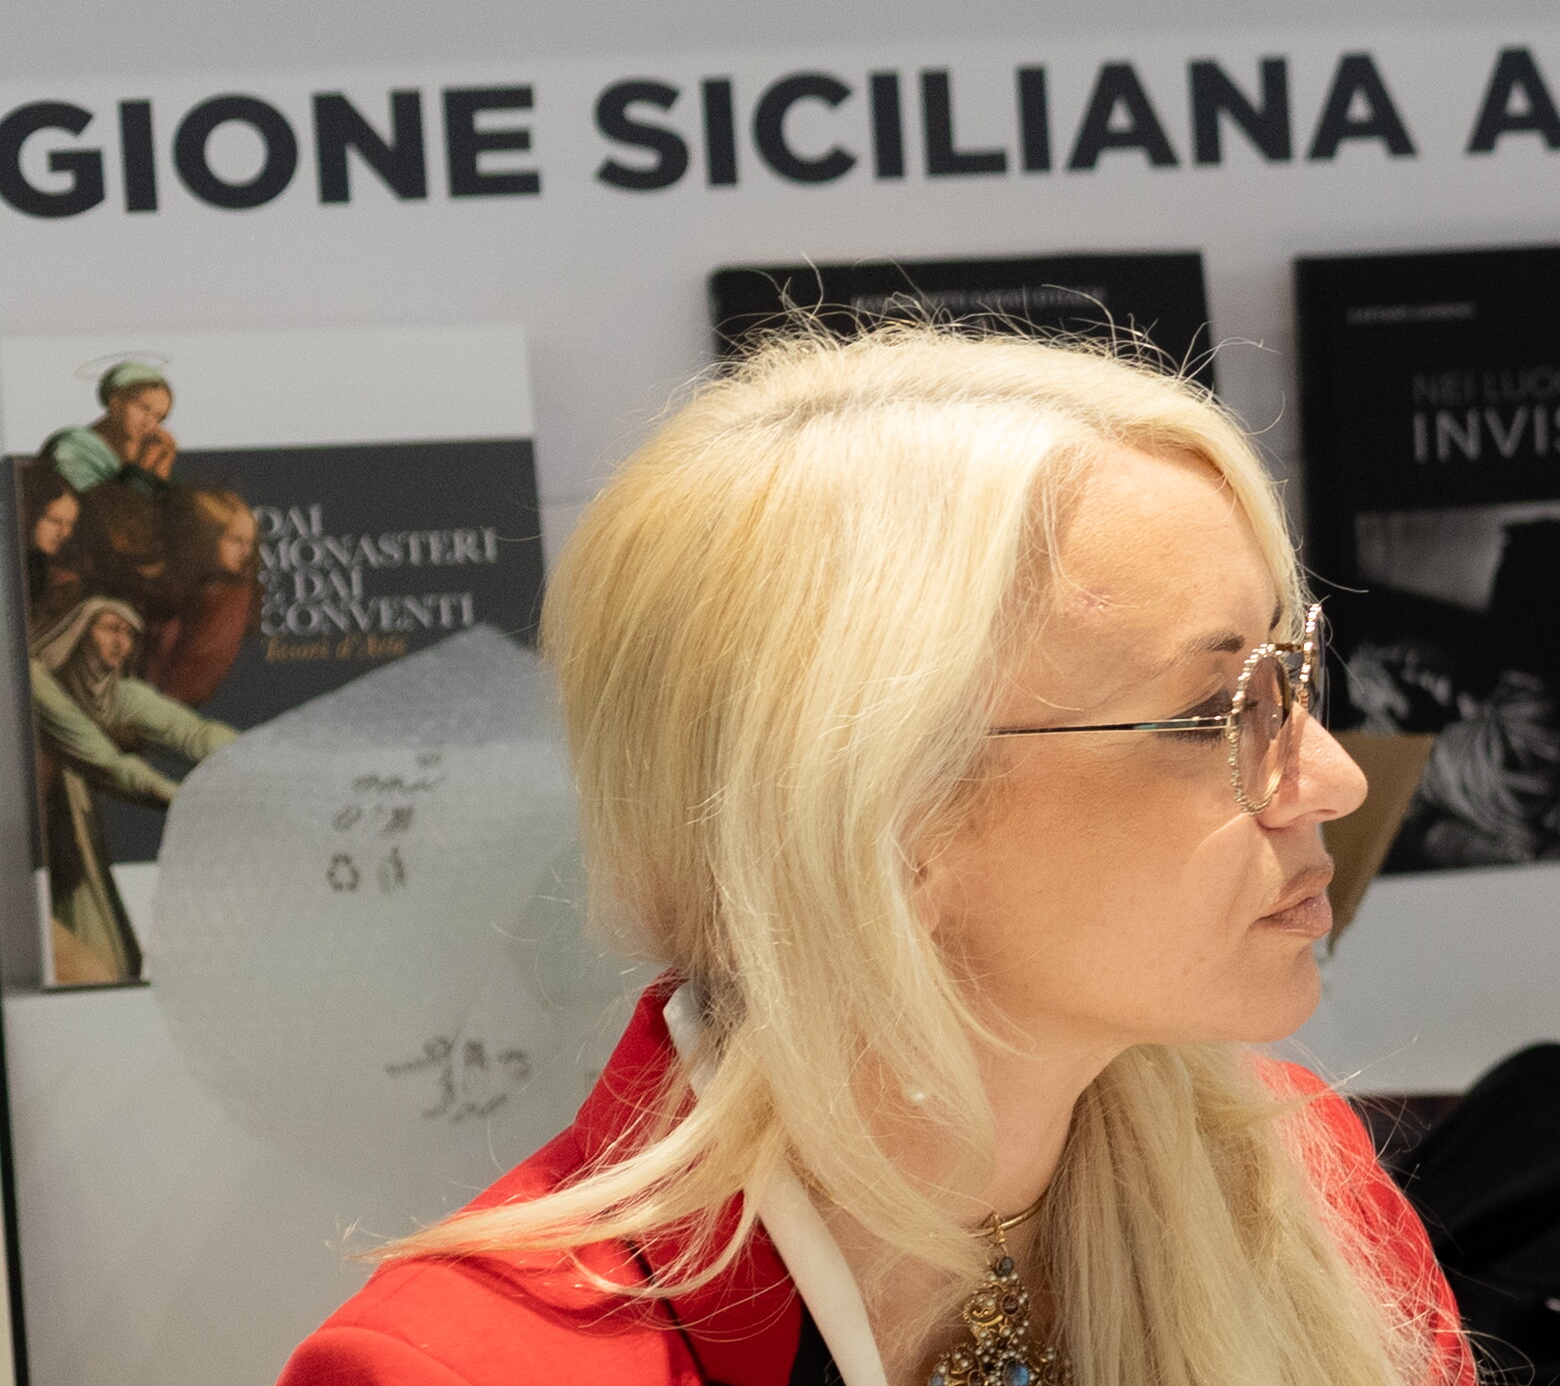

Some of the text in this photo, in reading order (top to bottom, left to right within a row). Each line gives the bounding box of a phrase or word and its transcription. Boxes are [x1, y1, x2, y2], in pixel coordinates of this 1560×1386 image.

[593, 51, 1417, 196] SICILIANA
[253, 503, 323, 540] DAI
[259, 527, 498, 572] MONASTERI
[294, 565, 363, 604] DAI
[261, 593, 474, 635] CONVENTI
